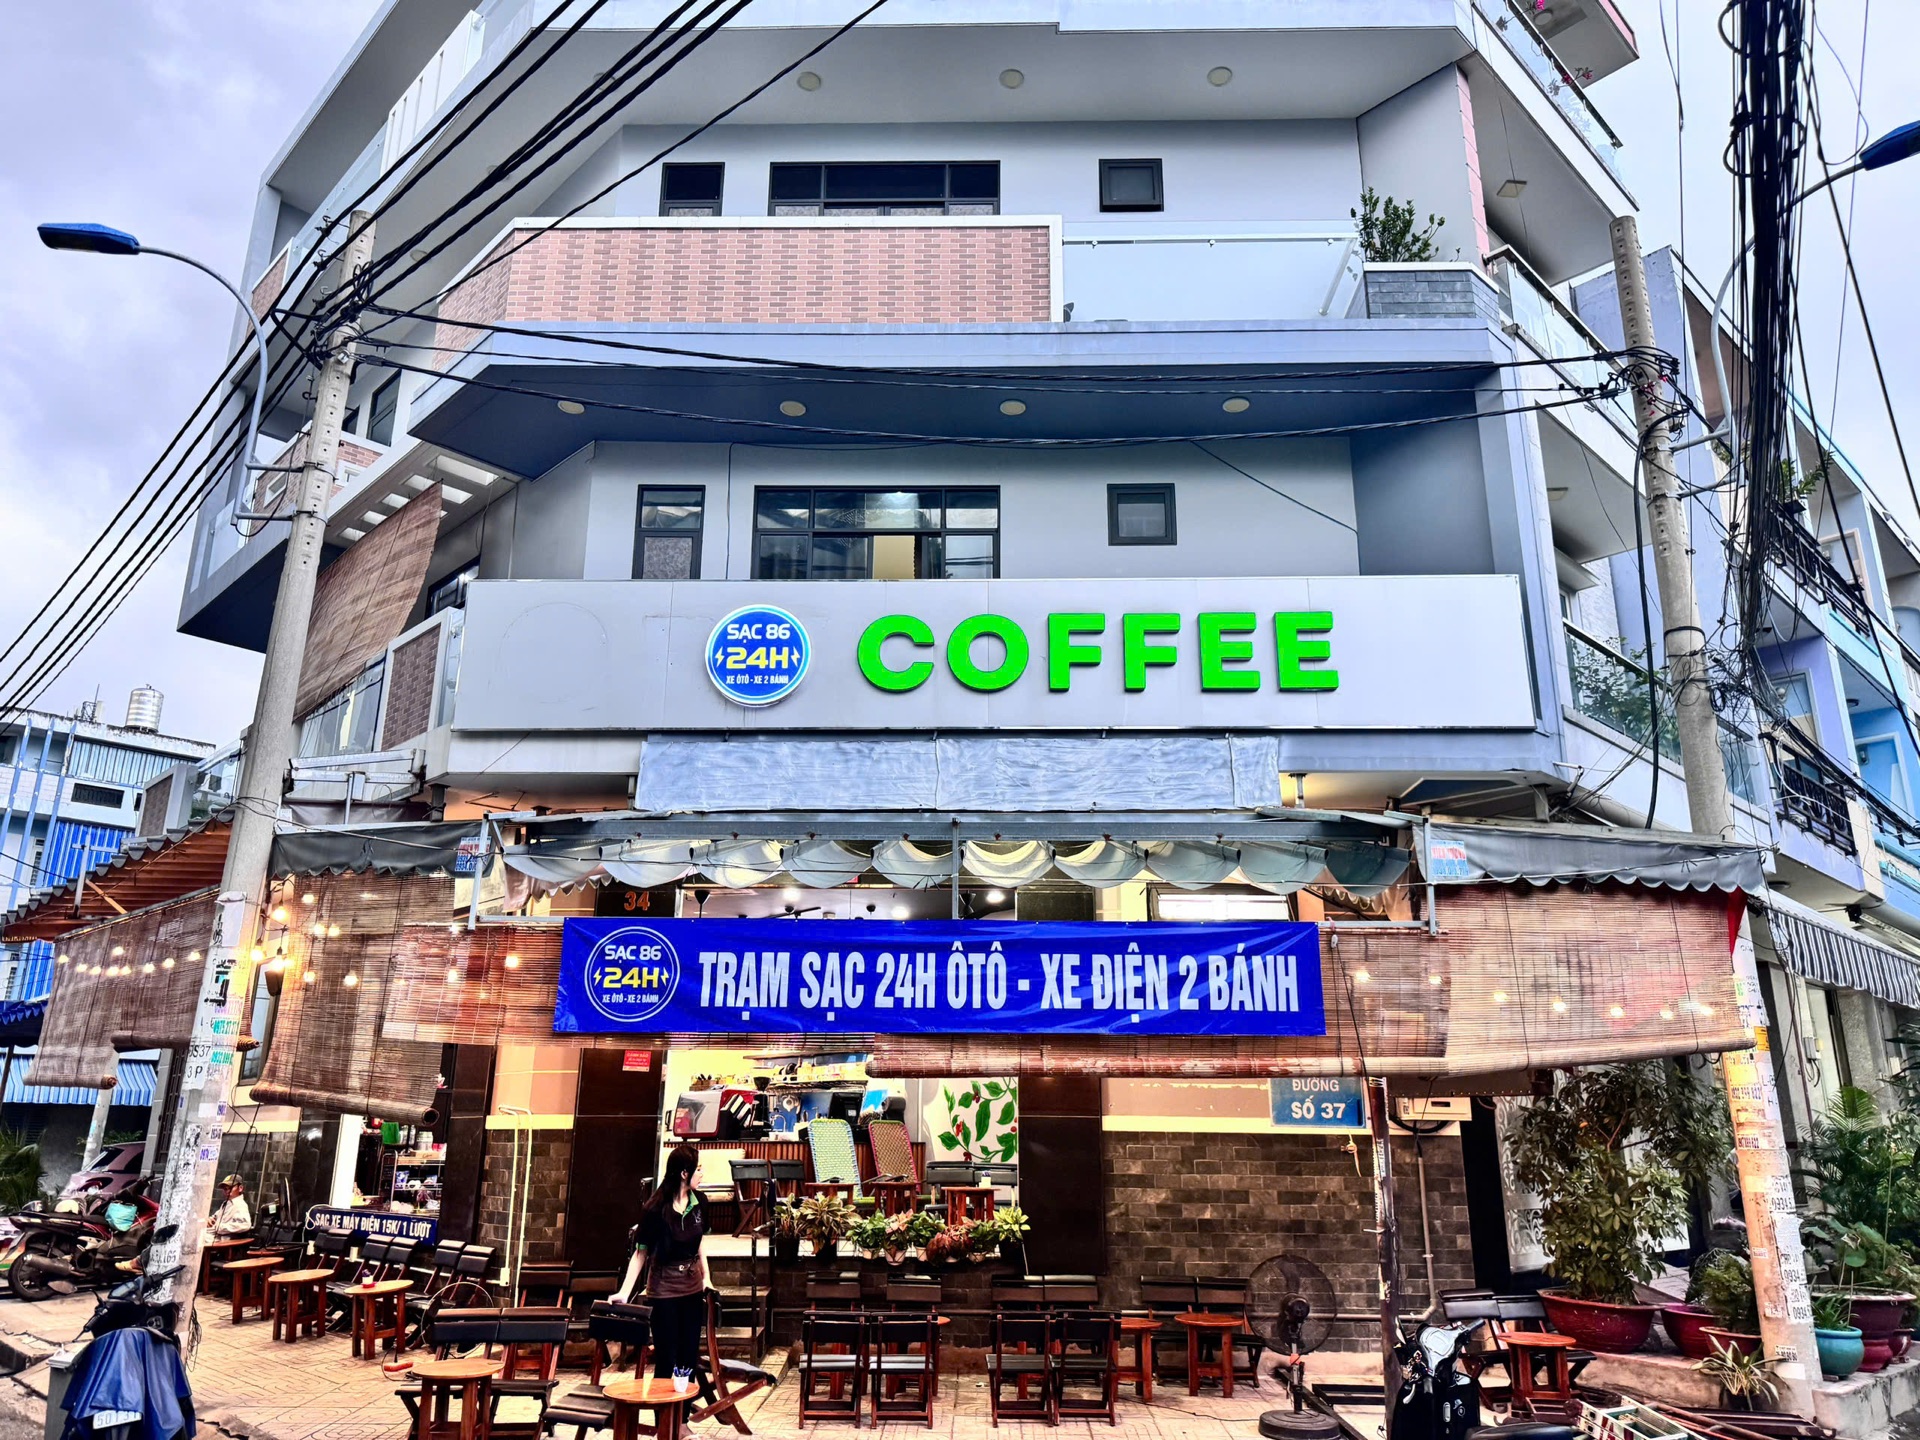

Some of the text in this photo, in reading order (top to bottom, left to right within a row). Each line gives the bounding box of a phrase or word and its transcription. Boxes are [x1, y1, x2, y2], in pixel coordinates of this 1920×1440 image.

[726, 623, 791, 644] SẠC 86
[726, 646, 789, 669] 24H
[857, 611, 1340, 695] COFFEE
[725, 674, 735, 684] XE
[736, 673, 749, 684] ÔTÔ
[753, 674, 763, 684] XE
[763, 674, 769, 684] 2
[769, 673, 789, 684] BÁNH
[624, 890, 651, 911] 34
[604, 944, 662, 964] SẠC 86
[603, 967, 660, 989] 24H
[699, 951, 790, 1021] TRẠM
[800, 951, 866, 1022] SẠC
[874, 952, 937, 1009] 24H
[946, 940, 1008, 1010] ÔTÔ
[1040, 953, 1083, 1010] XE
[1091, 942, 1170, 1024] ĐIỆN
[1178, 954, 1200, 1011] 2
[1208, 943, 1300, 1013] BÁNH
[602, 994, 611, 1003] XE
[627, 994, 636, 1003] XE
[636, 994, 642, 1003] 2
[1292, 1077, 1341, 1092] ĐƯỜNG
[1290, 1095, 1347, 1120] SỐ 37
[331, 1214, 342, 1228] XE
[342, 1213, 361, 1230] MÁY
[361, 1215, 380, 1235] ĐIỆN
[382, 1219, 400, 1235] 15K/
[402, 1221, 407, 1236] 1
[409, 1221, 432, 1241] LƯỢT
